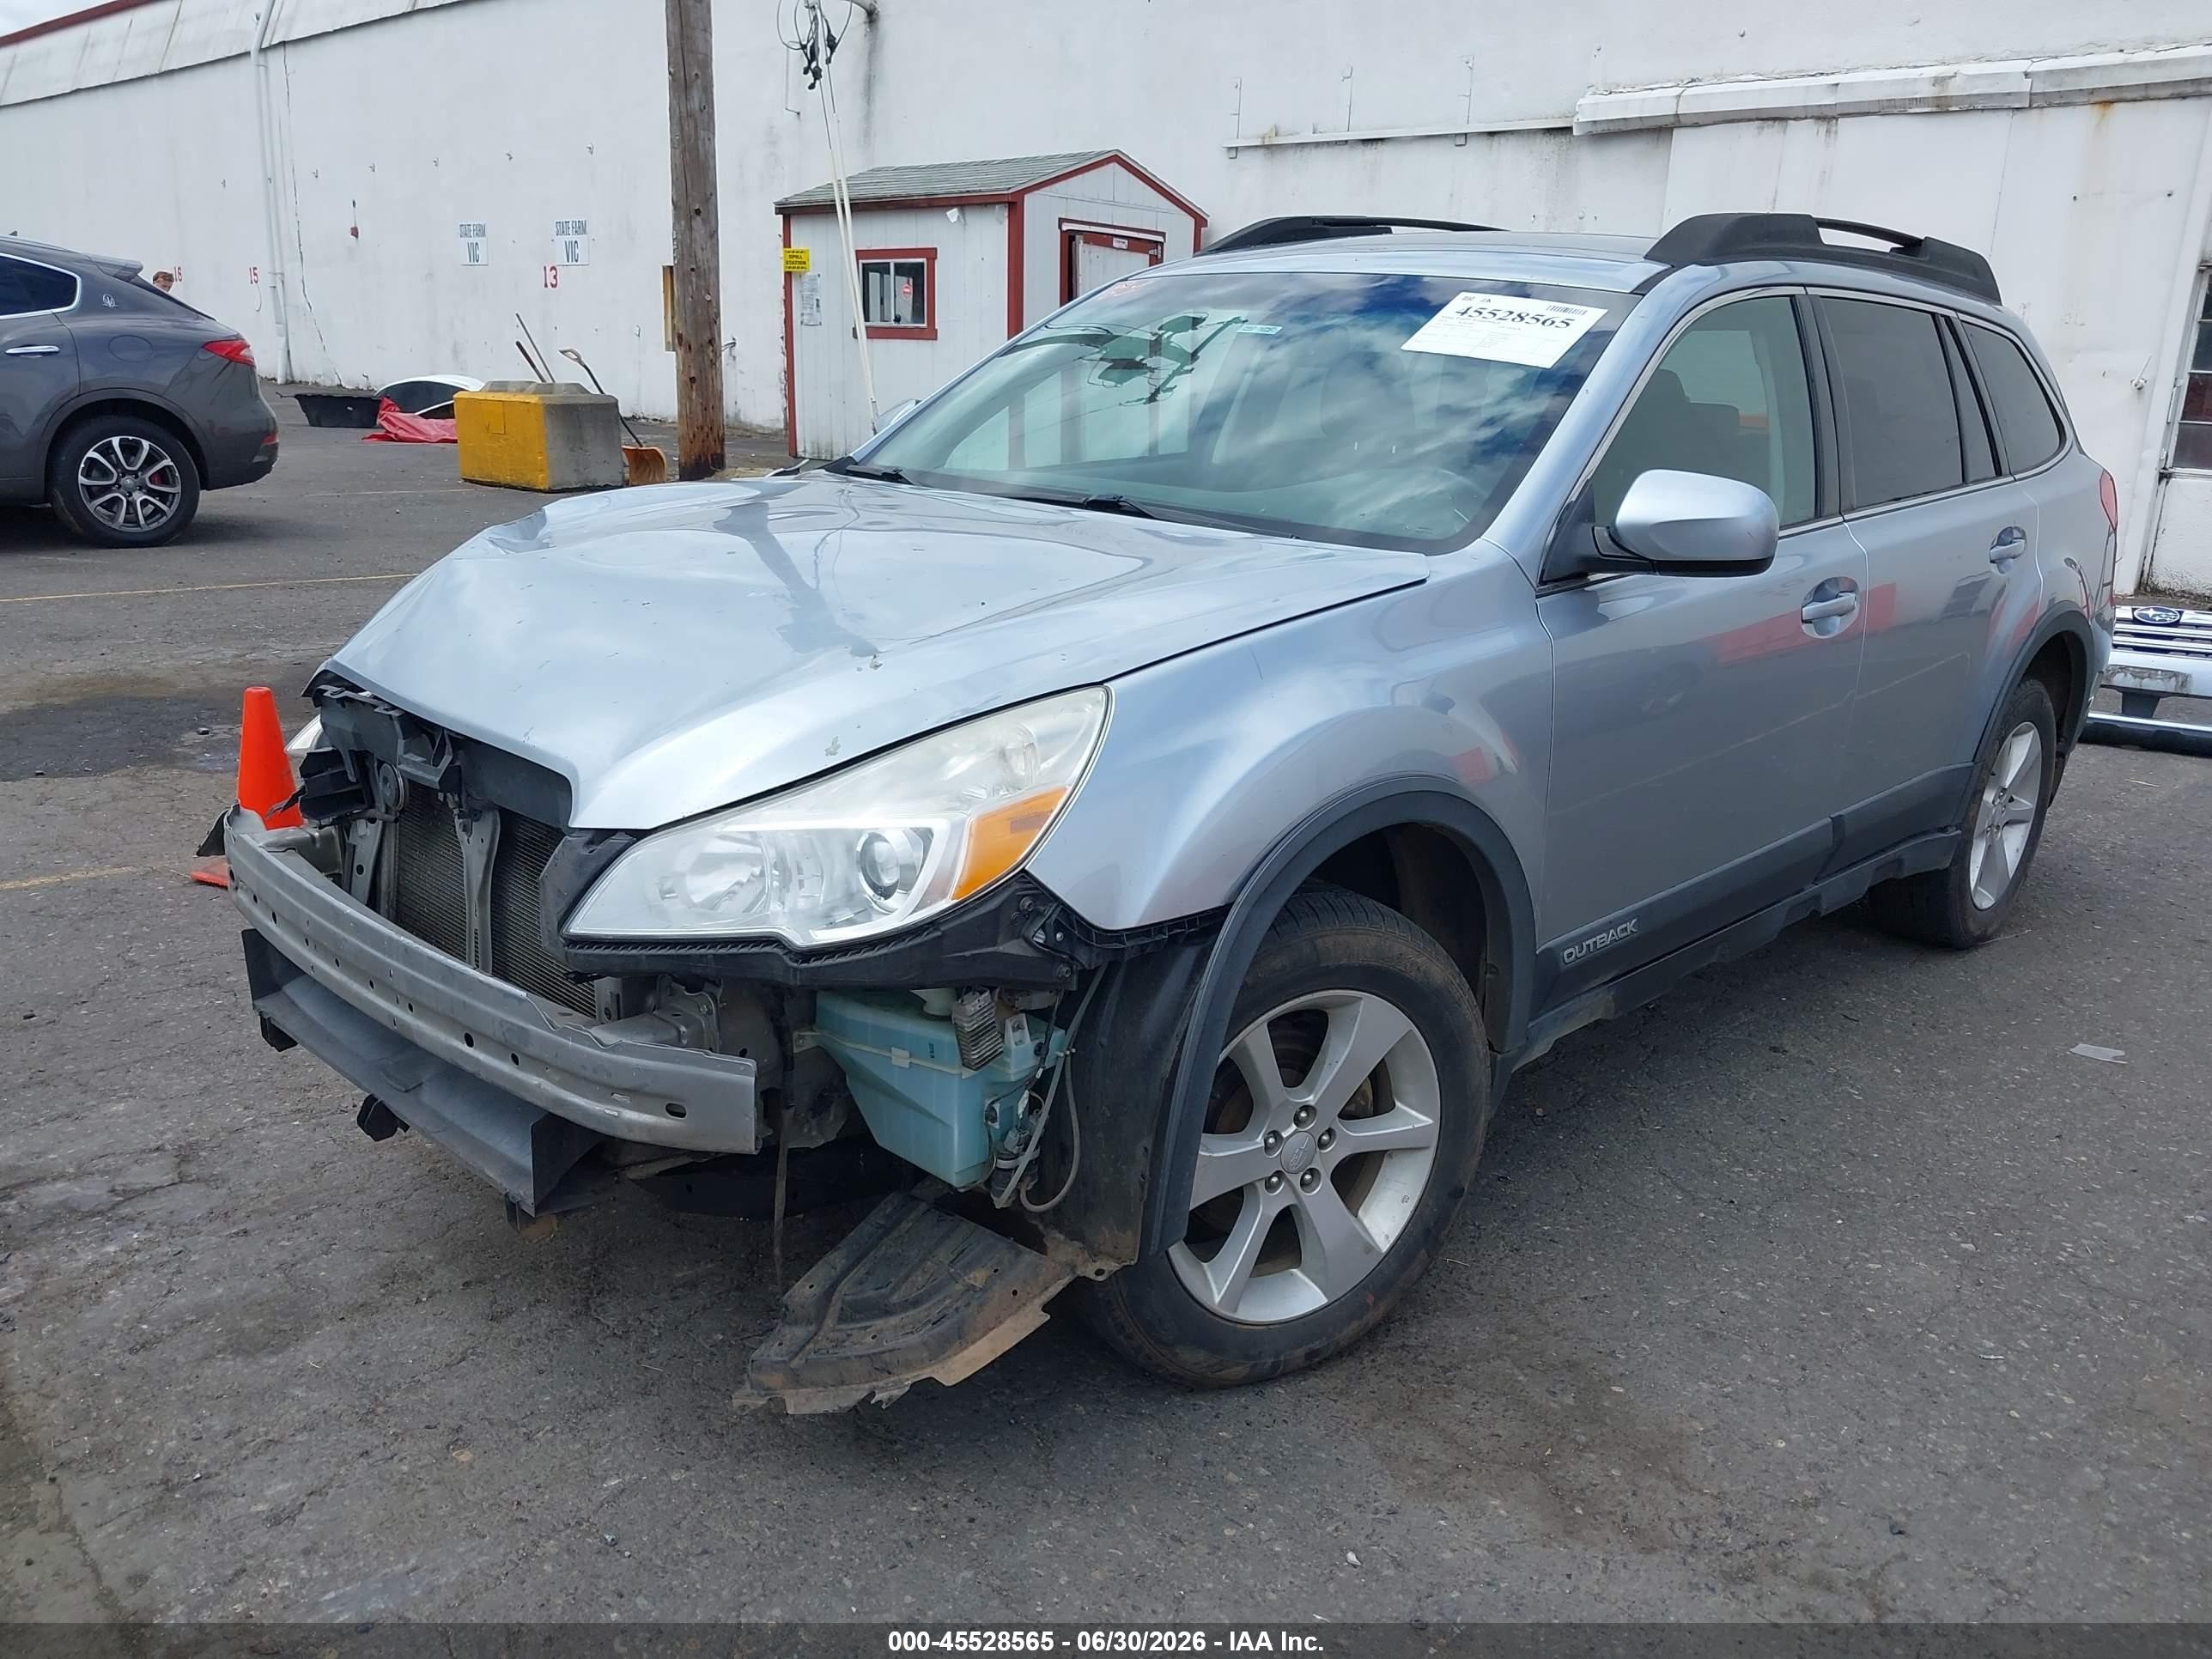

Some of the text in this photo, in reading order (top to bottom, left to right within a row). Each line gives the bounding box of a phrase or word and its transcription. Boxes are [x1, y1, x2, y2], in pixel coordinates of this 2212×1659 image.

[459, 223, 486, 238] STATE FARM
[556, 219, 587, 236] STATE FARM
[467, 241, 480, 263] VIC
[564, 240, 579, 263] VIC
[173, 266, 183, 283] 16
[249, 267, 258, 284] 15
[543, 265, 558, 289] 13
[1455, 306, 1576, 329] 45528565
[1563, 918, 1638, 964] OUTBACK
